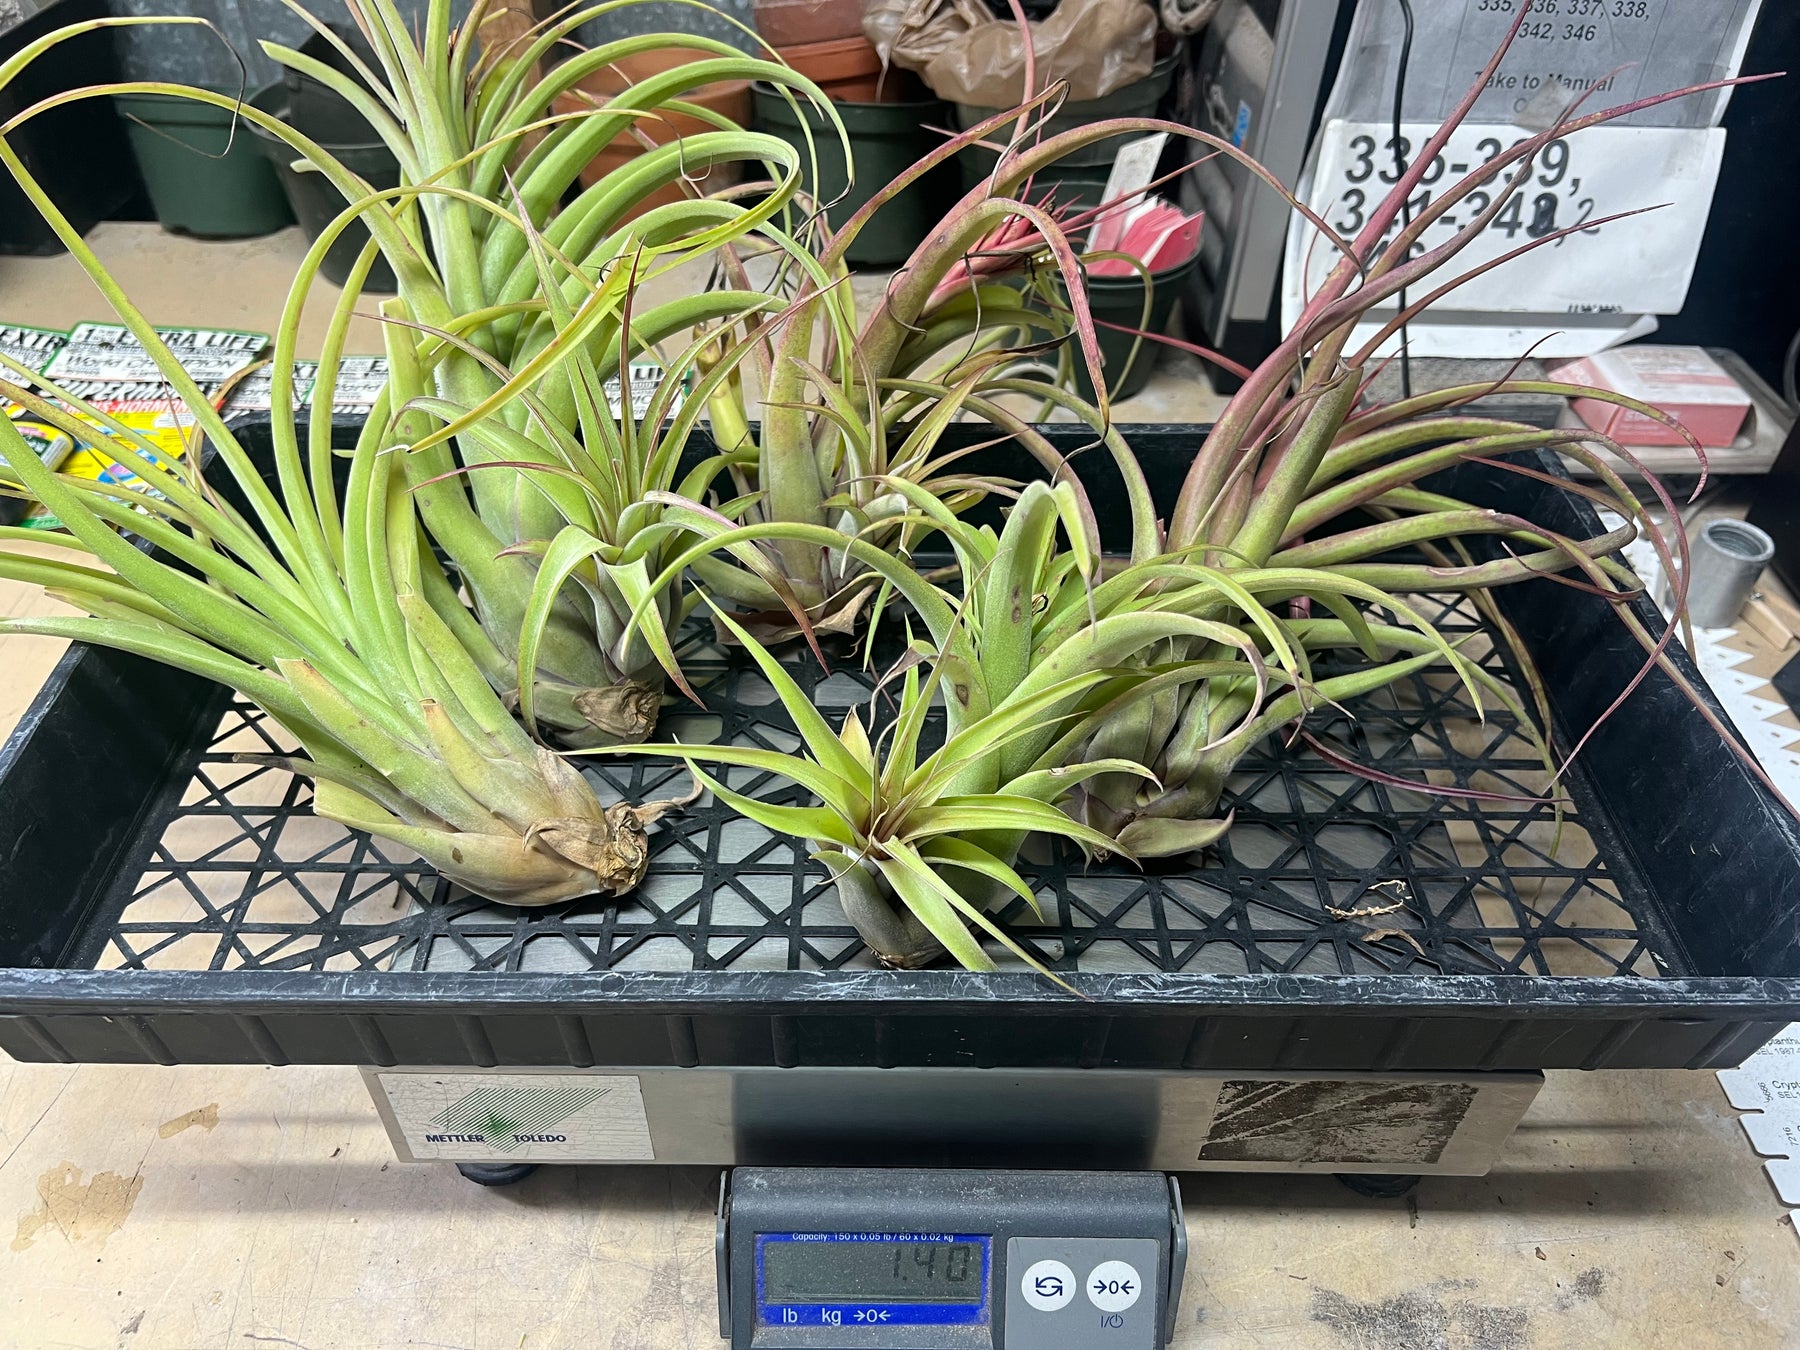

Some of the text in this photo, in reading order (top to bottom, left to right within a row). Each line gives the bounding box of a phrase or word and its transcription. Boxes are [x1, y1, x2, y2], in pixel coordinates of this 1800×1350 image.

[1612, 2, 1650, 21] 338,
[1519, 22, 1597, 42] 342, 346
[1523, 74, 1540, 90] to
[205, 333, 260, 351] LIFE
[425, 1134, 567, 1143] METTLER TOLEDO
[792, 1232, 830, 1242] Capacity:
[834, 1232, 851, 1241] 150
[860, 1232, 880, 1241] 0.05
[883, 1232, 891, 1241] lb
[899, 1232, 911, 1241] 60
[920, 1232, 941, 1241] 0.02
[943, 1232, 954, 1243] kg
[893, 1246, 971, 1282] 1.40
[782, 1308, 798, 1323] lb
[821, 1308, 842, 1325] kg
